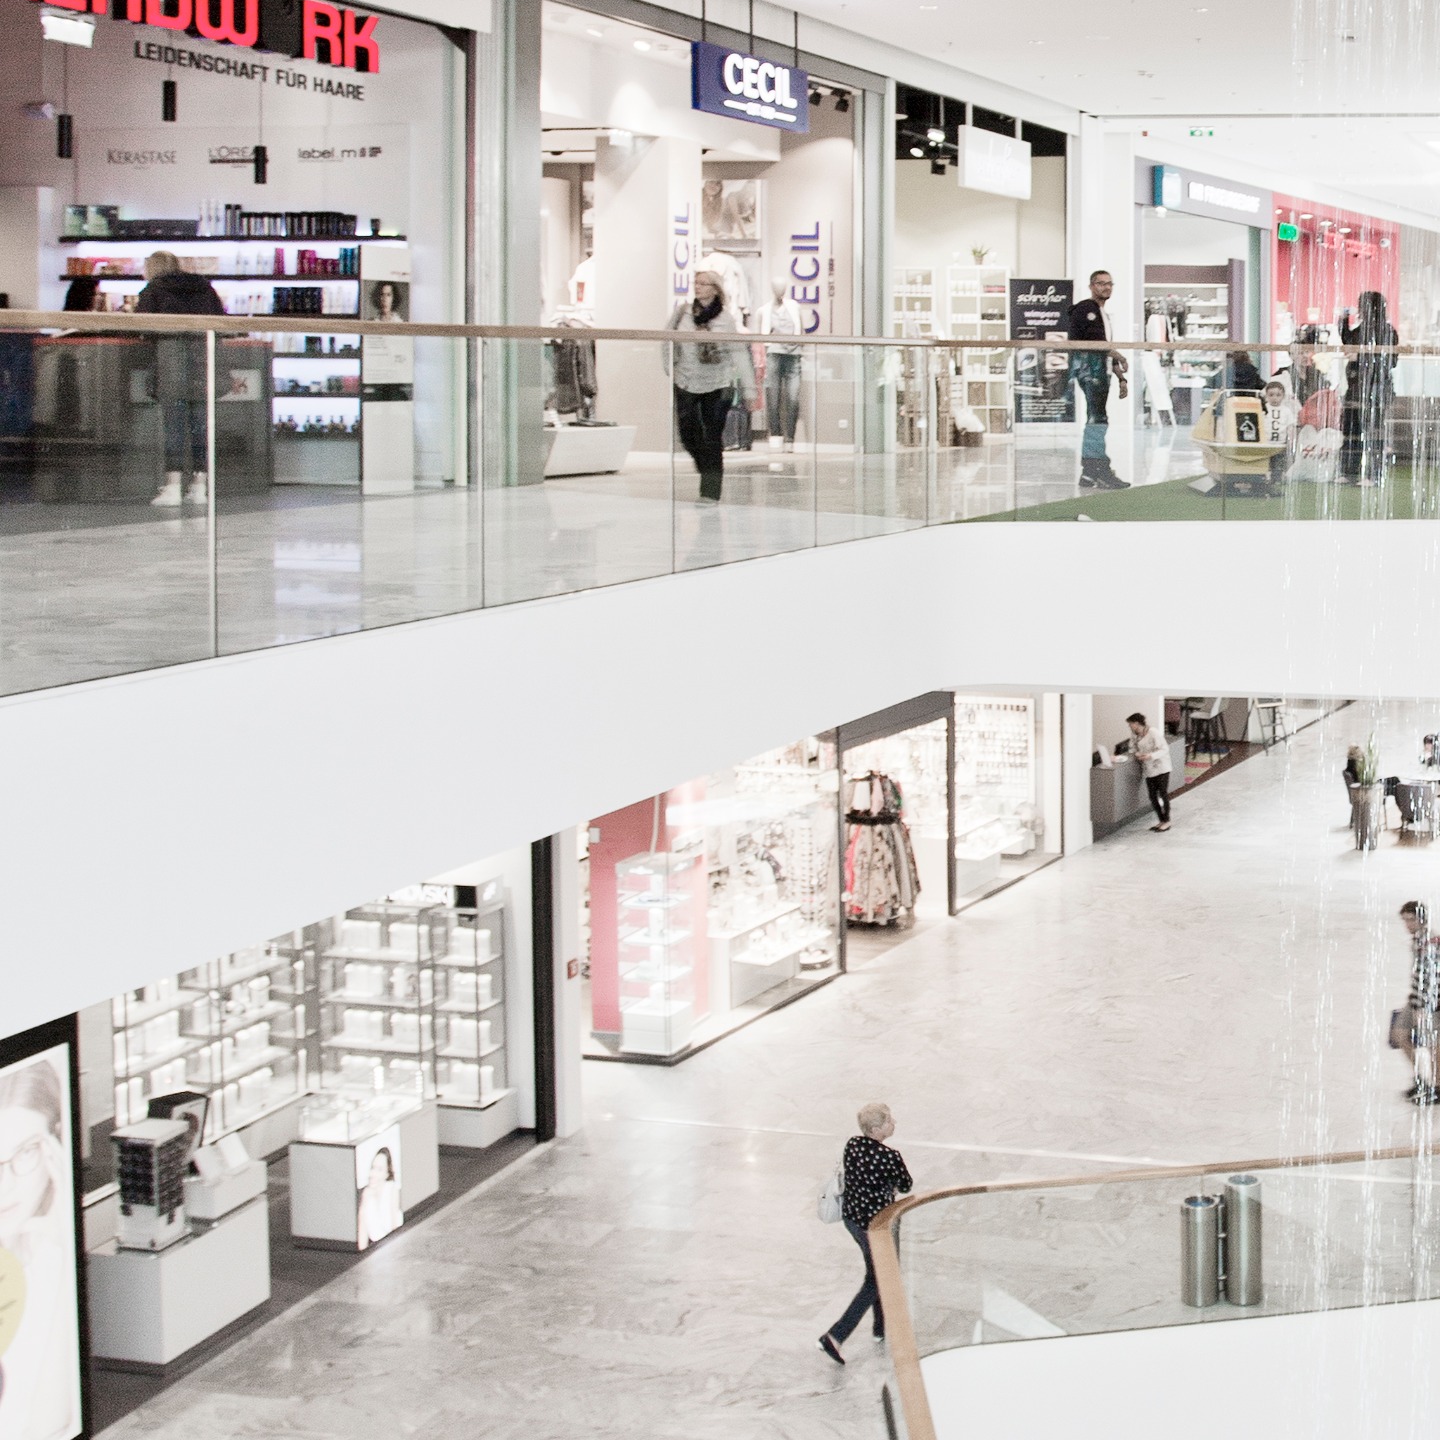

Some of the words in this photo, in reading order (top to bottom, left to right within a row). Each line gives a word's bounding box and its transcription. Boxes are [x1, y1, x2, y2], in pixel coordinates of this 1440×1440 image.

[133, 40, 270, 83] LEIDENSCHAFT
[275, 67, 307, 91] FÜR
[313, 76, 365, 102] HAARE
[724, 53, 798, 109] CECIL
